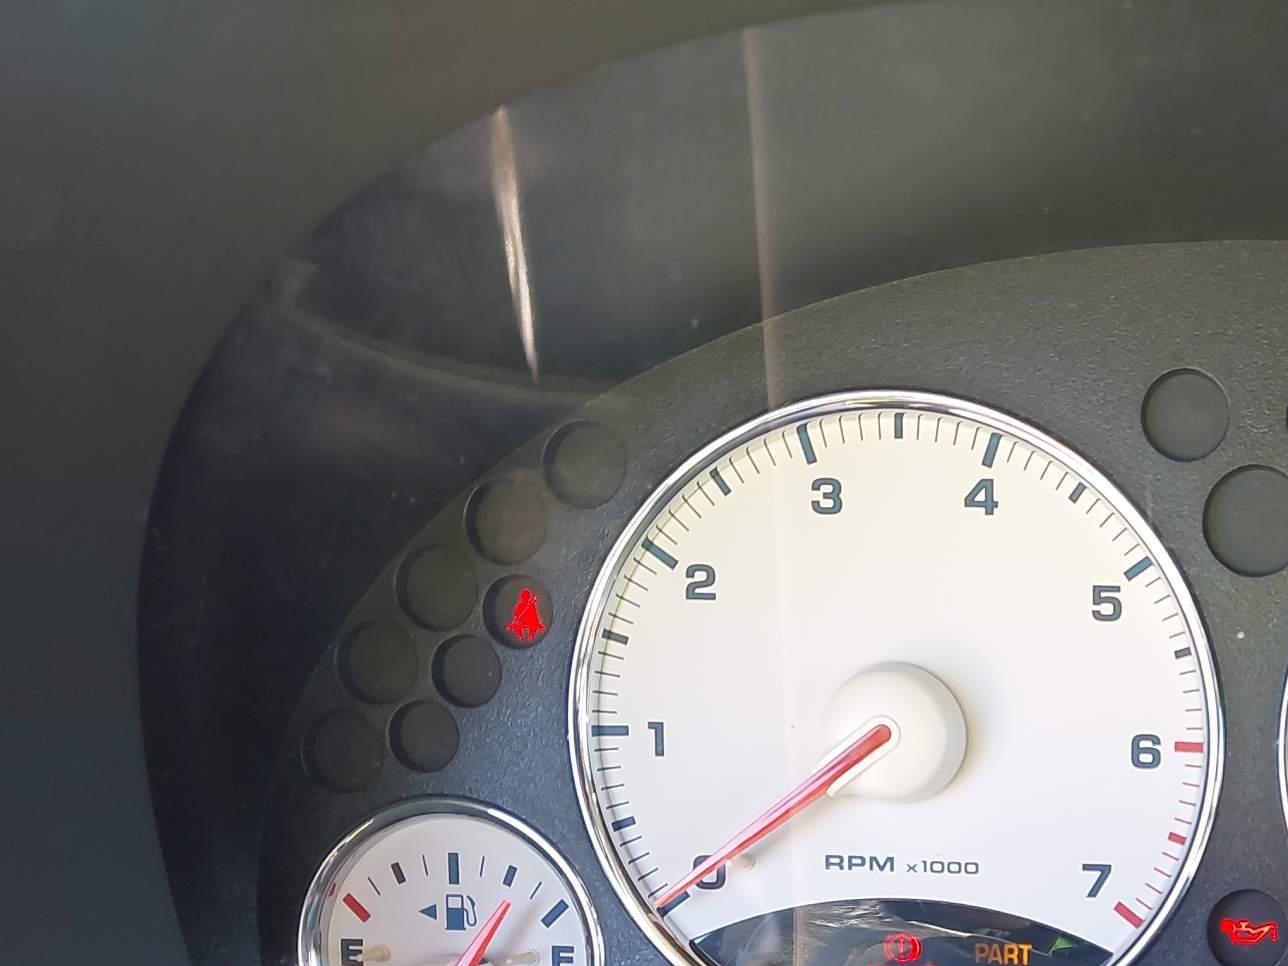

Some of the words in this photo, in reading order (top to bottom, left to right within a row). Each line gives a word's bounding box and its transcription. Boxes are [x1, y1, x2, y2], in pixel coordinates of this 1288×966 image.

[811, 478, 842, 514] 3
[964, 479, 998, 515] 4
[686, 564, 716, 600] 2
[1092, 585, 1122, 621] 5
[648, 722, 664, 756] 1
[1131, 734, 1161, 768] 6
[692, 855, 727, 890] 0
[826, 855, 894, 872] RPM
[907, 861, 978, 874] x1000
[1082, 864, 1111, 897] 7
[976, 943, 1032, 965] PART
